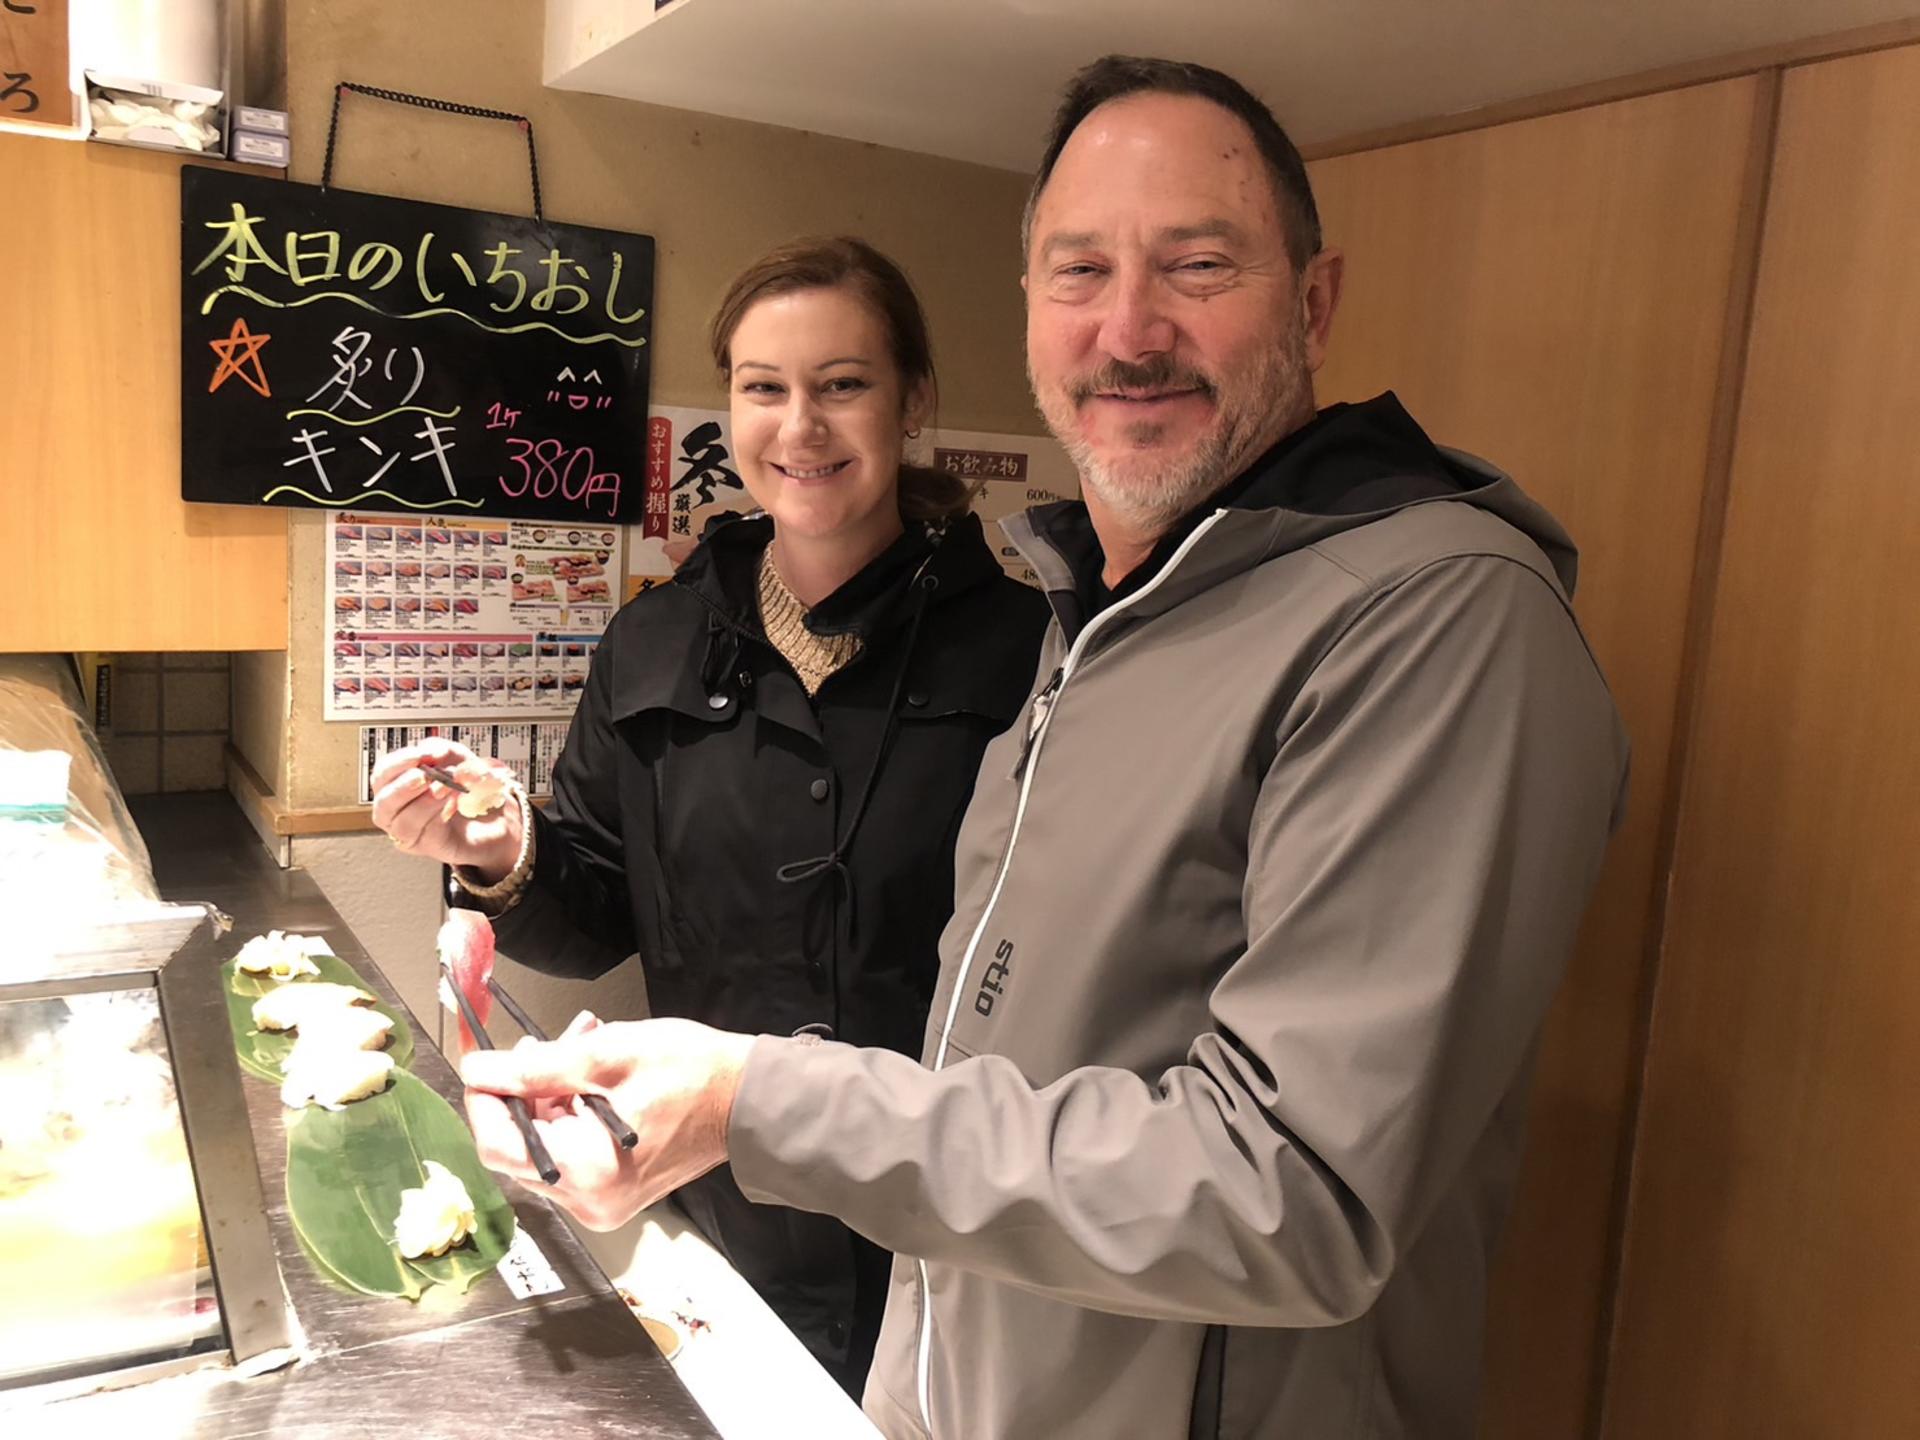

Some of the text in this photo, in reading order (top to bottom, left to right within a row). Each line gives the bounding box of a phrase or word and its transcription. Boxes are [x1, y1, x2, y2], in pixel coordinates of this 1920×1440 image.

[191, 202, 645, 323] 本日のいちおし
[306, 326, 425, 411] 炙り
[283, 417, 457, 497] キンキ
[499, 438, 621, 518] 380円
[645, 424, 668, 533] おすすめ握り
[669, 421, 744, 510] 冬
[944, 454, 1019, 476] お飲み物
[975, 938, 1014, 1017] stio
